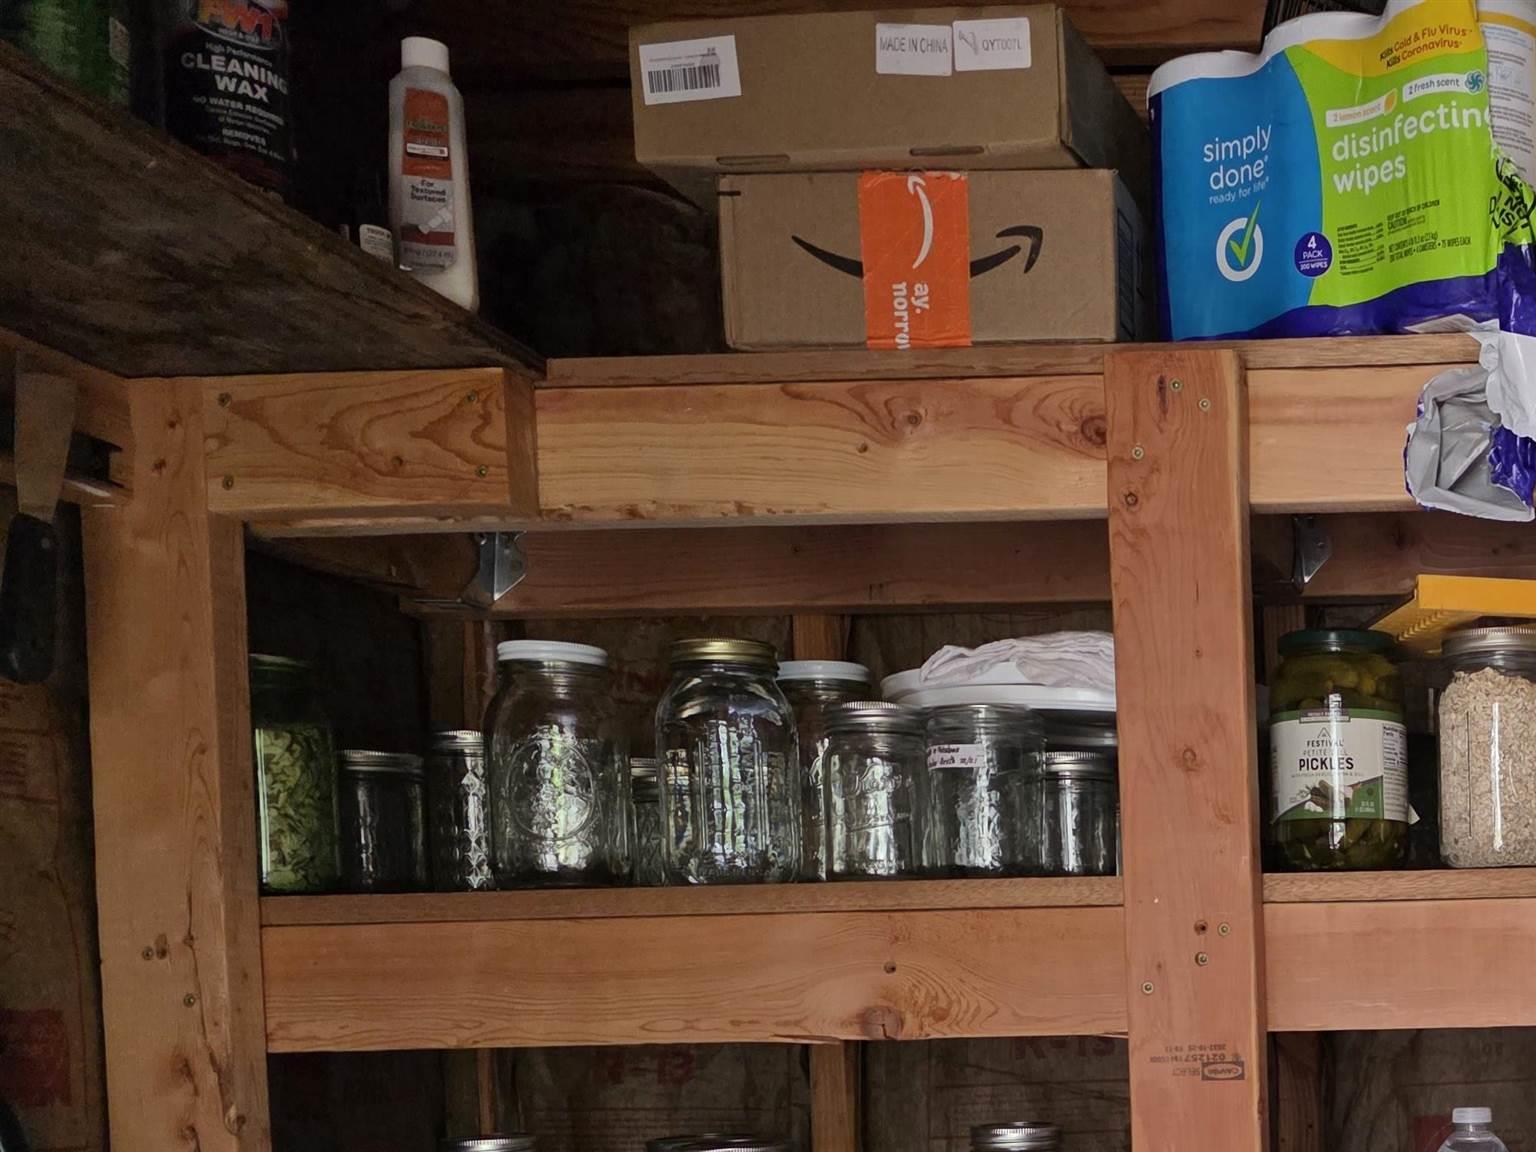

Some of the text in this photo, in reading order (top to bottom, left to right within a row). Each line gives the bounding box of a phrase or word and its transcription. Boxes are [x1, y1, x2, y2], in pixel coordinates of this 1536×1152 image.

[879, 37, 949, 54] MADE IN CHINA
[1394, 35, 1412, 52] Cold
[1413, 32, 1420, 43] &
[1421, 26, 1437, 39] Flu
[180, 52, 289, 95] CLEANING
[214, 74, 269, 103] WAX
[1408, 77, 1460, 95] 2 fresh scent
[208, 97, 244, 111] WATER
[1203, 124, 1272, 163] simply
[1210, 159, 1265, 190] done
[1333, 154, 1407, 196] wipes
[1209, 190, 1237, 205] ready
[1238, 187, 1252, 199] for
[1307, 235, 1317, 249] 4
[1302, 250, 1323, 259] PACK
[1311, 260, 1328, 270] WIPES
[1298, 756, 1354, 771] PICKLES
